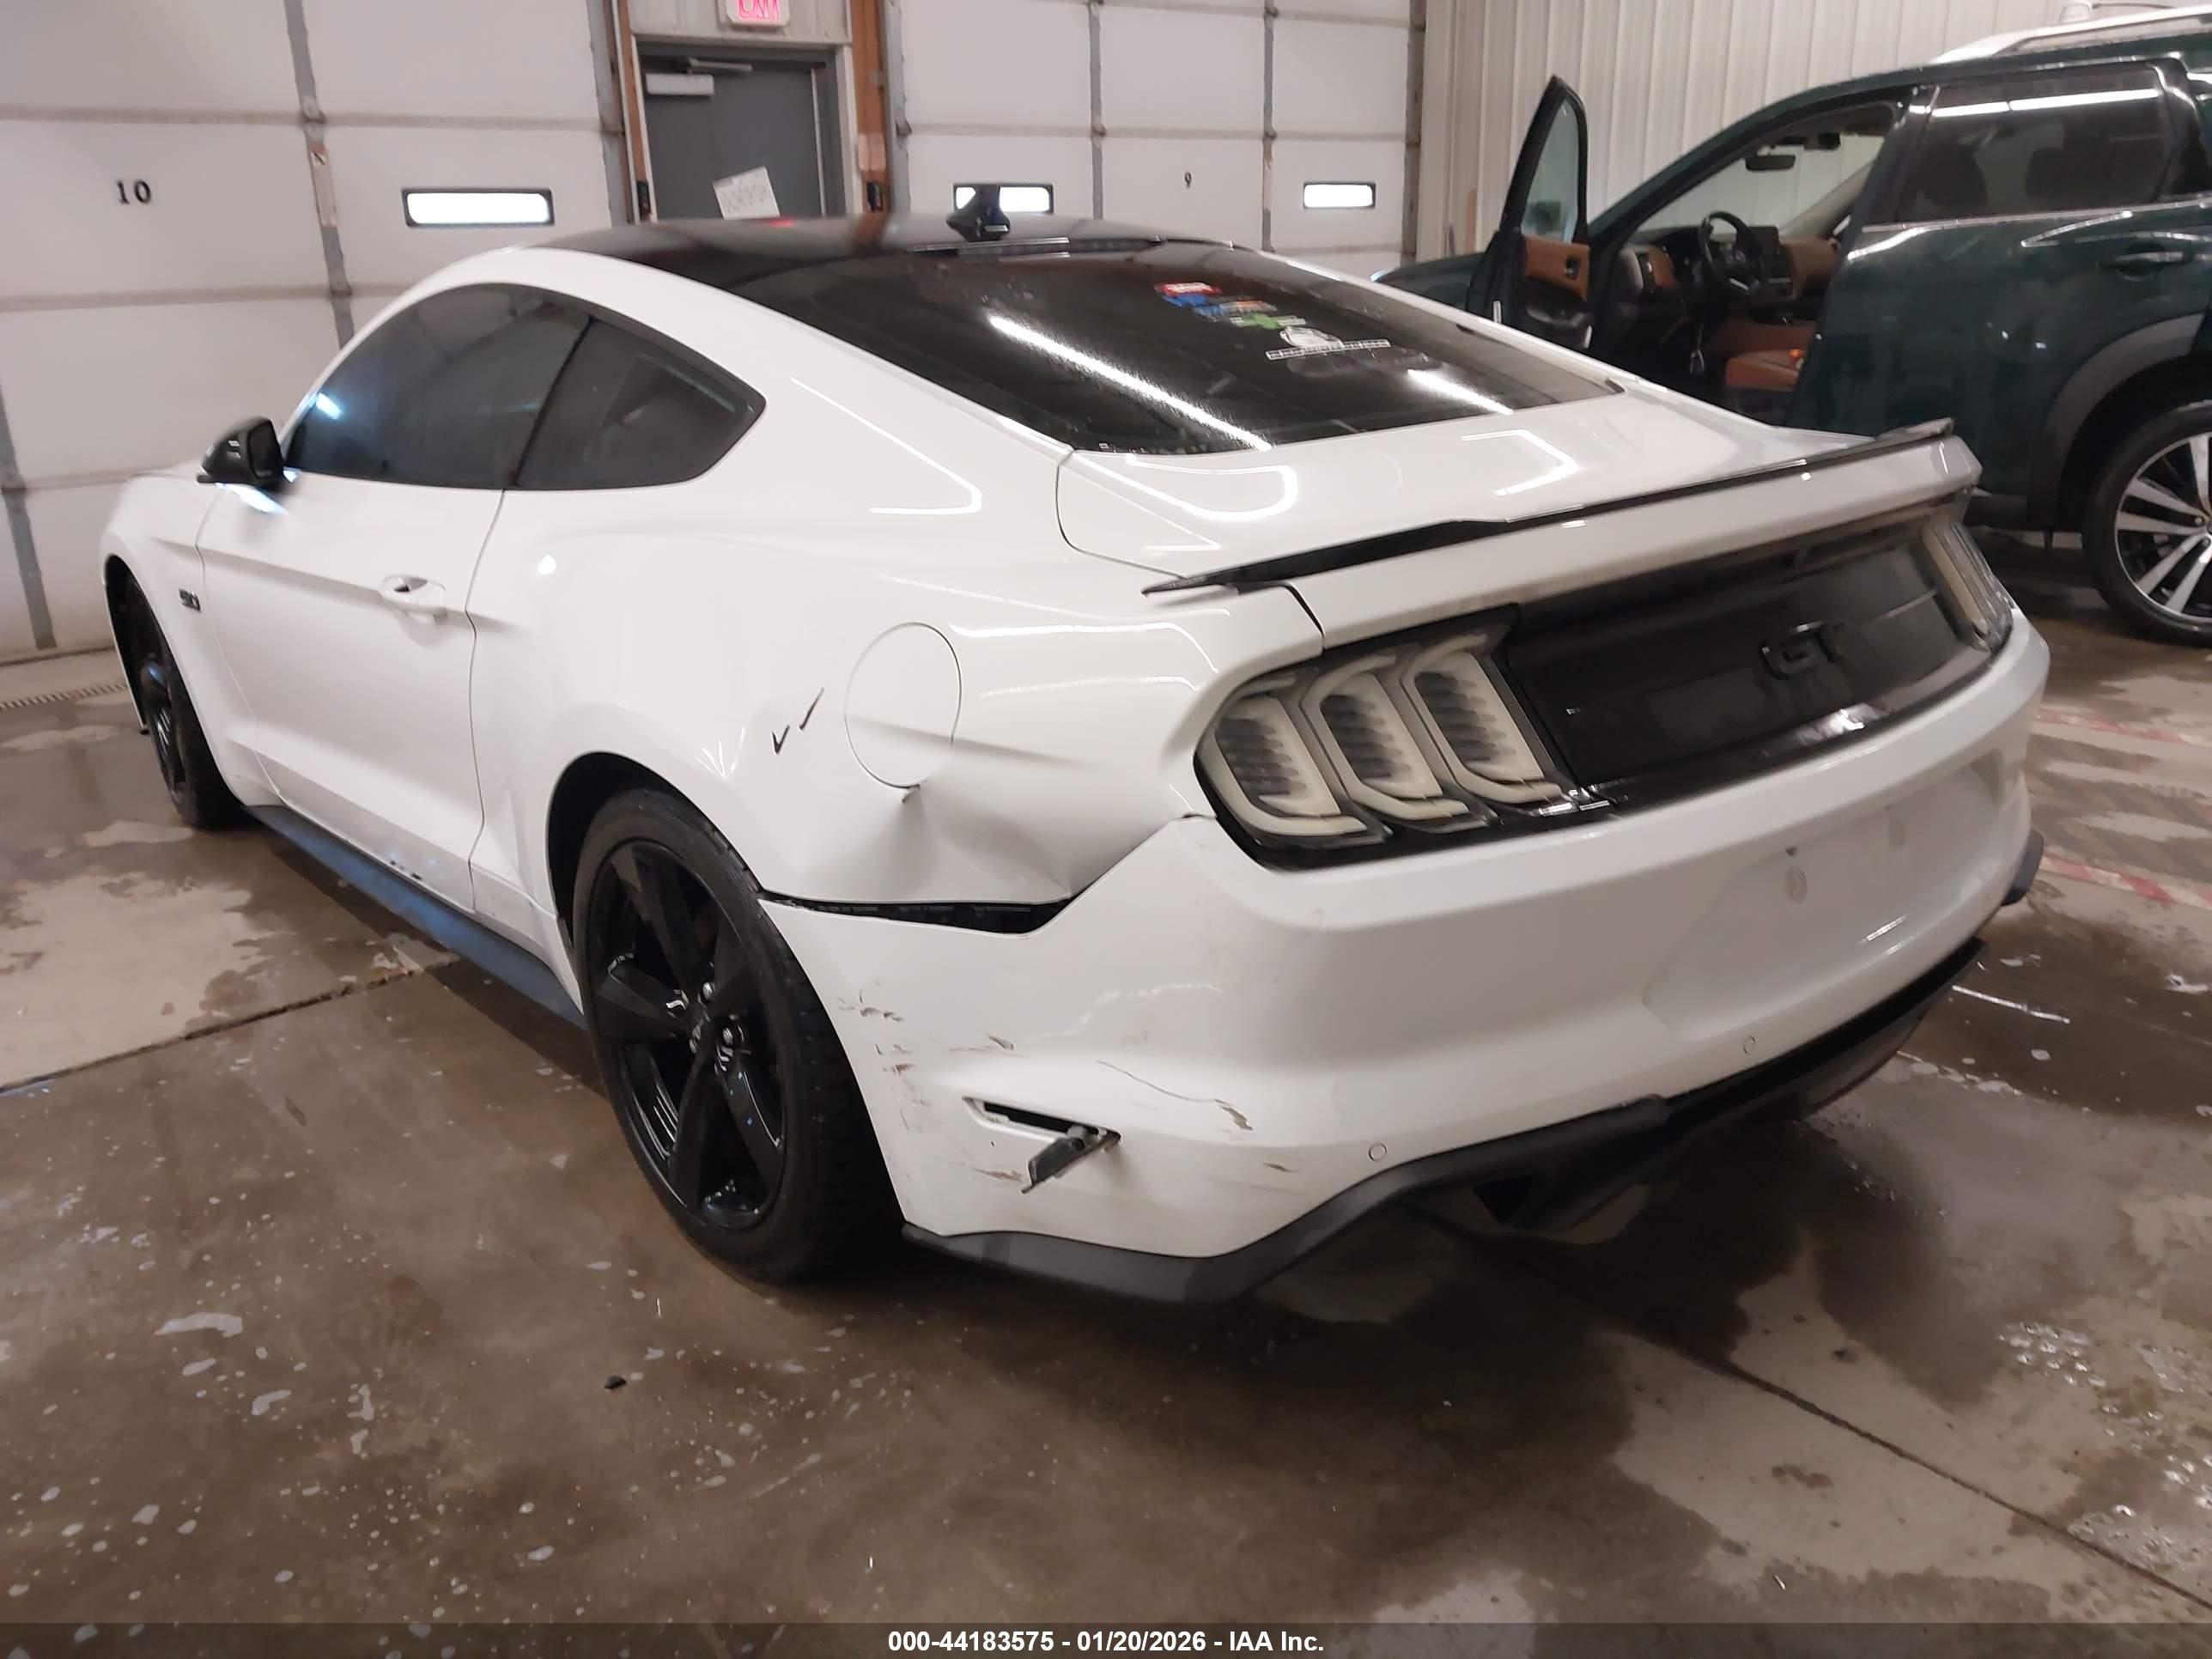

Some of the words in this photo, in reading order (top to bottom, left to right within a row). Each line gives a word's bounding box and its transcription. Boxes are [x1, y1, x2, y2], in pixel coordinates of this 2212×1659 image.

[116, 179, 152, 204] 10
[1184, 171, 1193, 190] 9
[1760, 622, 1842, 680] GT
